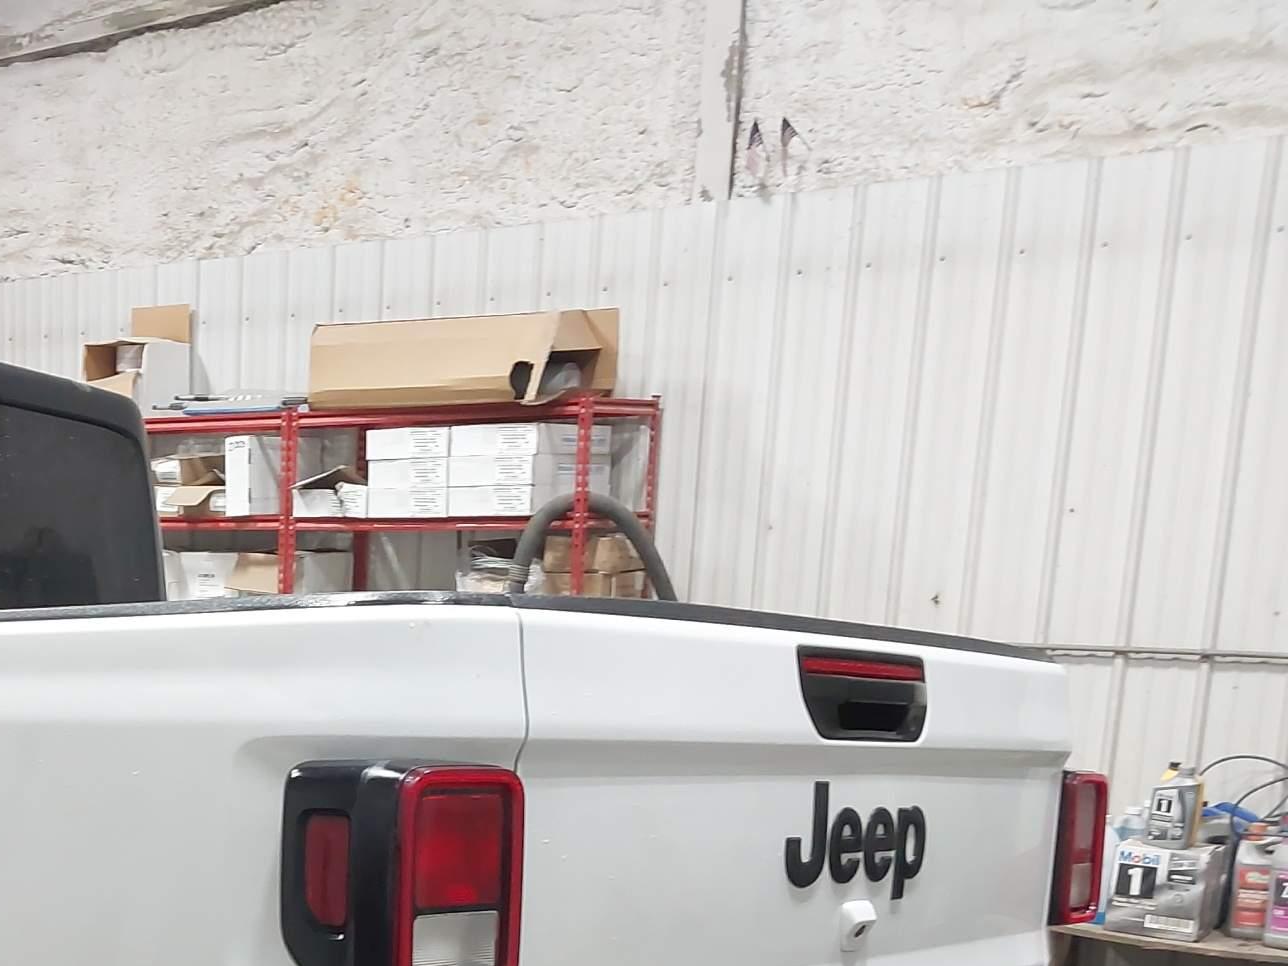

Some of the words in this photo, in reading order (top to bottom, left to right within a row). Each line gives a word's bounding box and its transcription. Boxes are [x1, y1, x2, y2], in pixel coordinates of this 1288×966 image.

[785, 780, 926, 900] Jeep
[1118, 850, 1161, 866] Mobil
[1127, 867, 1144, 896] 1
